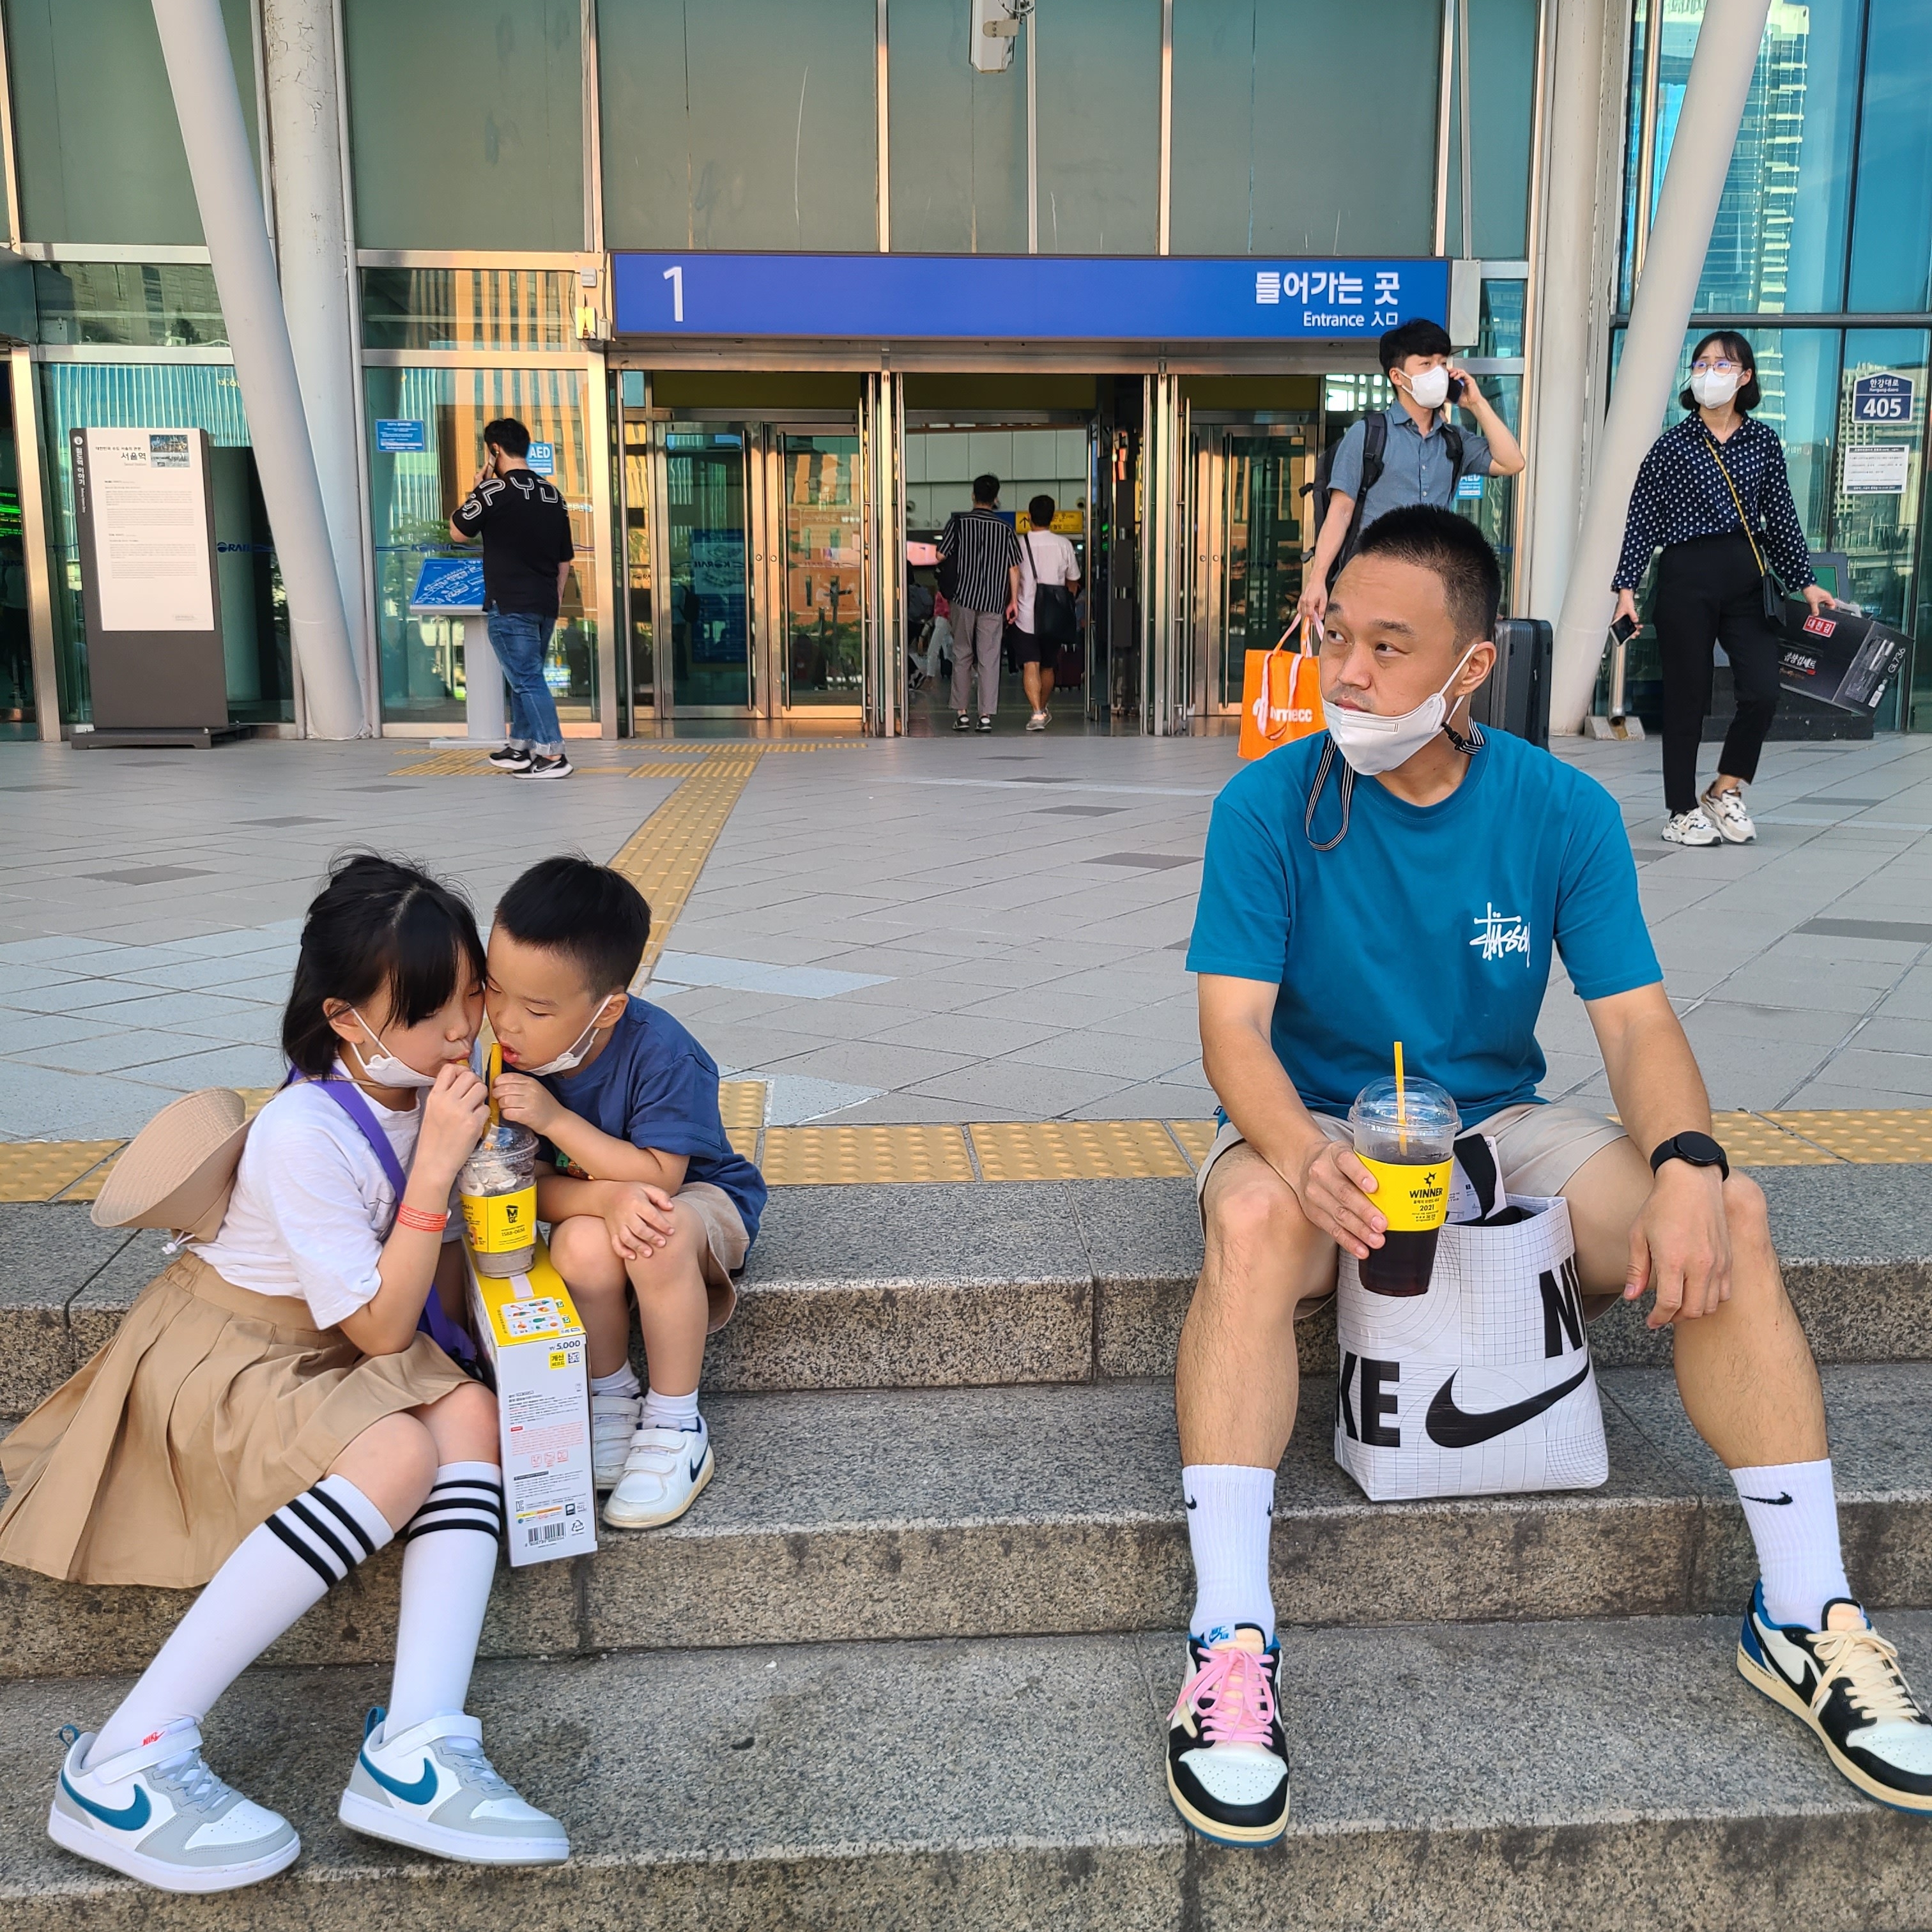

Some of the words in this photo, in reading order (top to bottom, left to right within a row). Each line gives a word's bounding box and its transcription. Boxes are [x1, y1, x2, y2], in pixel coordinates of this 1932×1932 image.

[663, 266, 684, 322] 1
[1255, 272, 1364, 305] 들어가는
[1374, 272, 1400, 305] 곳
[1303, 310, 1365, 327] Entrance
[1869, 378, 1899, 388] 한강대로
[1862, 397, 1902, 418] 405
[121, 452, 147, 461] 서울역
[529, 446, 551, 459] AED
[77, 467, 86, 486] 이야기
[1409, 1187, 1443, 1199] WINNER
